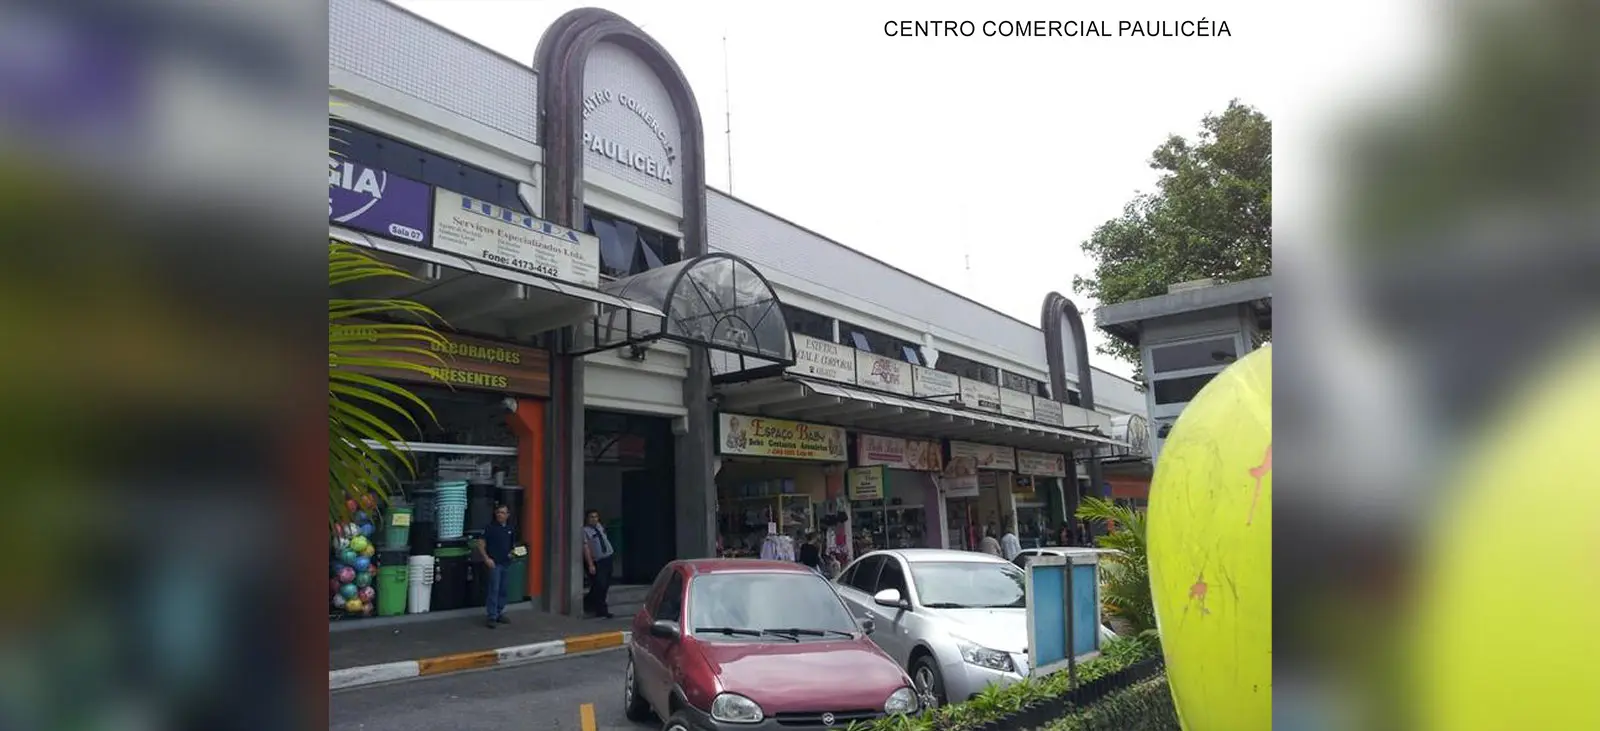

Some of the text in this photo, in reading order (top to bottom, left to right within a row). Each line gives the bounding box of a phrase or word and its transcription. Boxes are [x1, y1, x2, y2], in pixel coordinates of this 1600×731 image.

[582, 88, 677, 166] ENTRO COMERCIAL
[583, 130, 673, 185] PAULICÉIA
[391, 225, 421, 240] Sala 07
[452, 215, 495, 236] Serviços
[497, 228, 562, 255] Especializados
[482, 249, 509, 265] Fone:
[511, 258, 558, 277] 4173-4142
